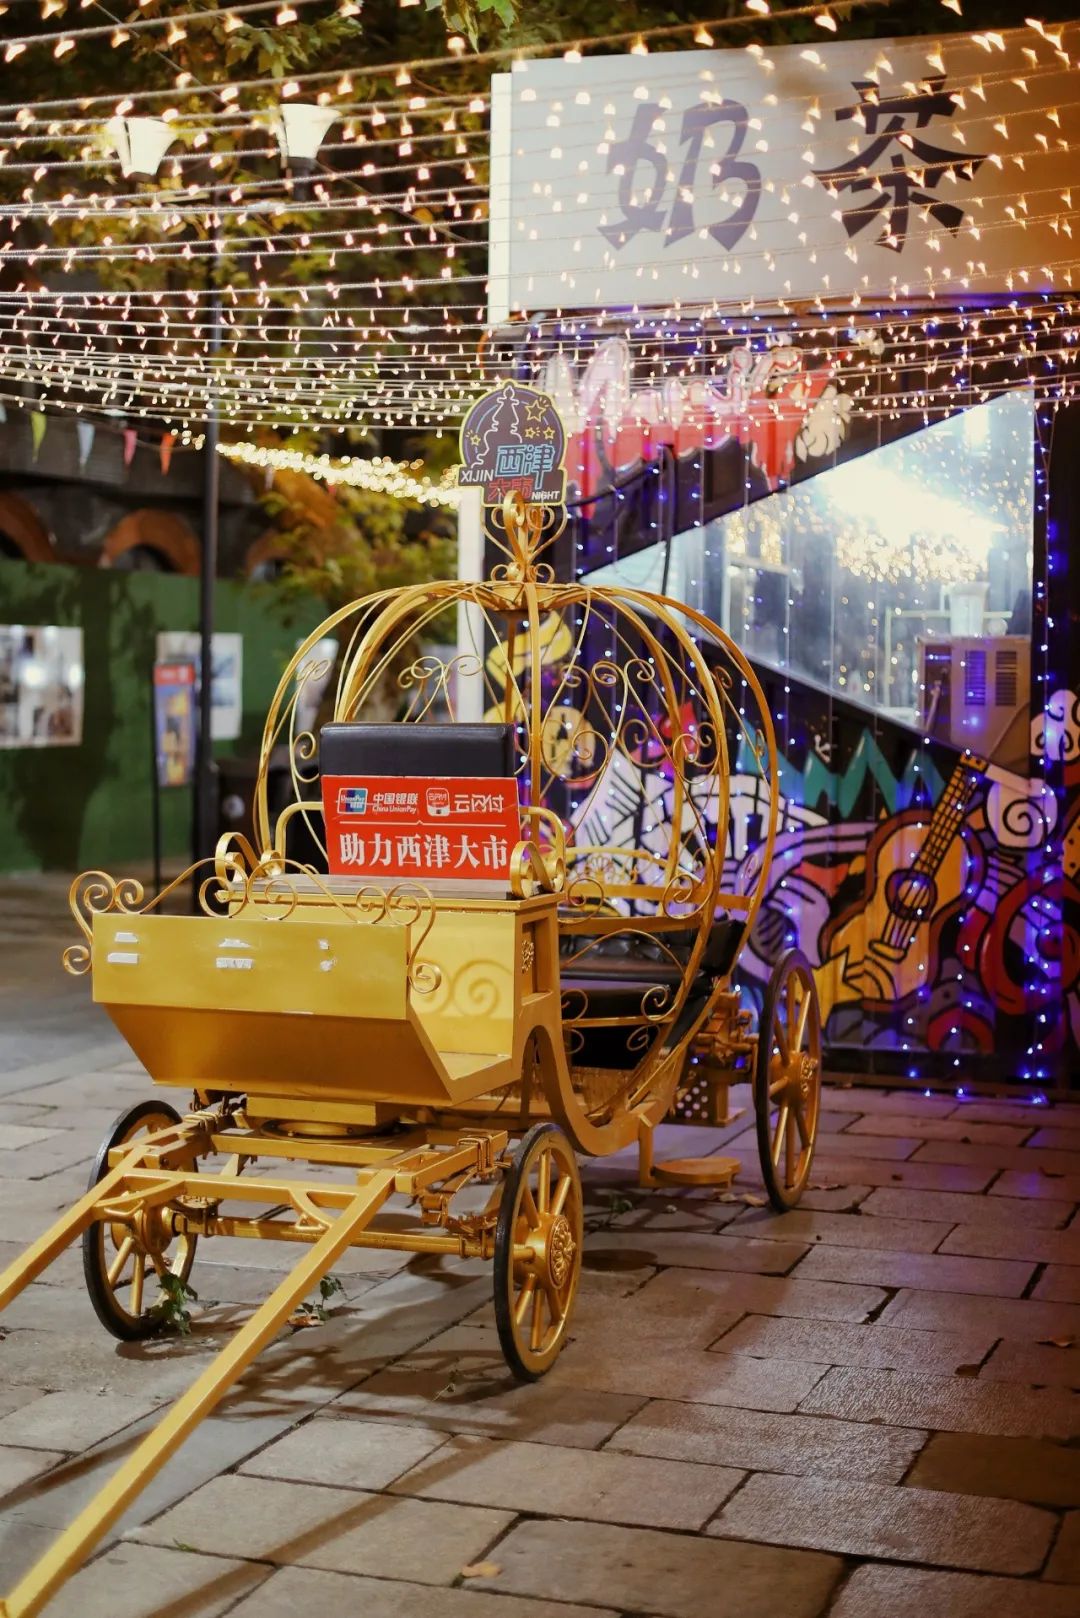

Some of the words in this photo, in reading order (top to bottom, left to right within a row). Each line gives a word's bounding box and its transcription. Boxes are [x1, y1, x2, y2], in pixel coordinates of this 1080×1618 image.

[597, 75, 989, 253] 奶茶
[495, 444, 555, 490] 西津
[461, 469, 494, 482] XIJIN
[531, 490, 560, 500] NIGHT
[373, 792, 418, 805] 中国银联
[454, 794, 504, 813] 云闪付
[372, 805, 389, 813] China
[389, 805, 417, 815] UnionPay
[339, 832, 508, 870] 助力西津大市
